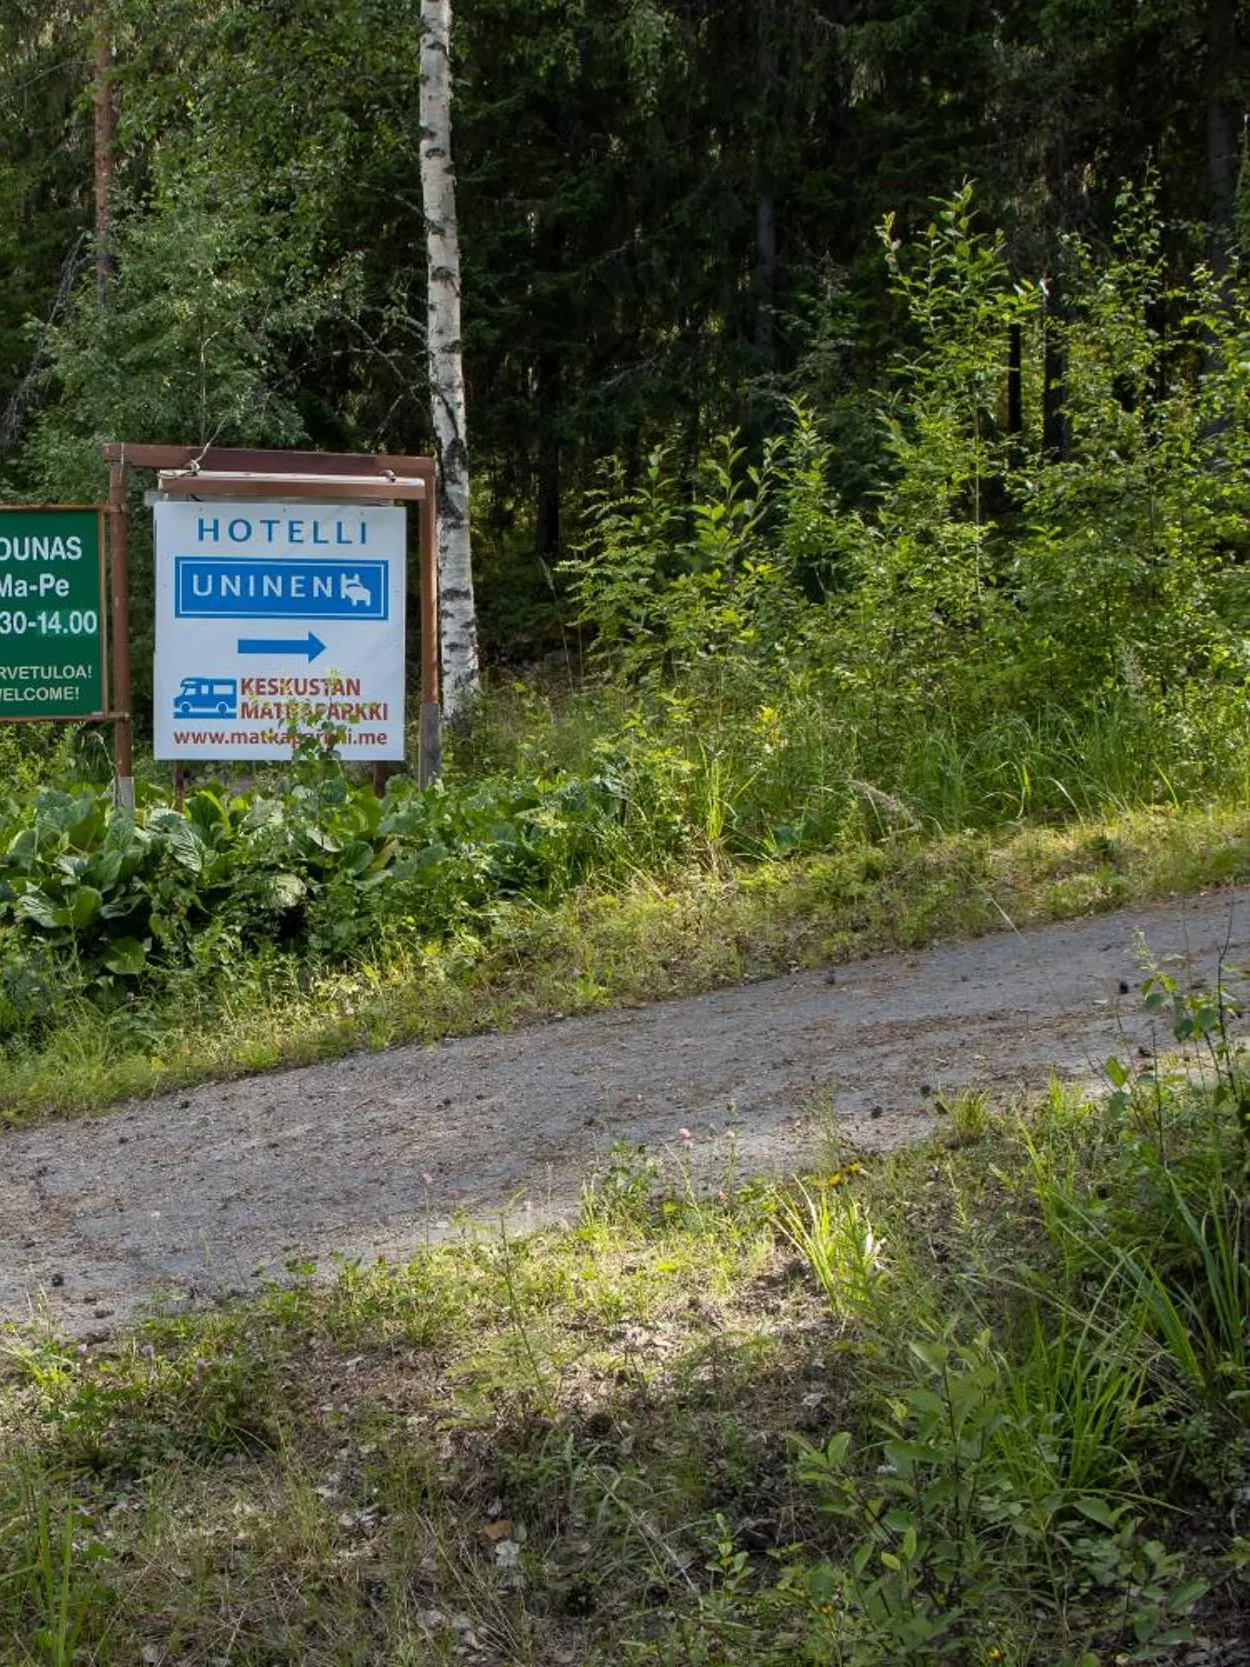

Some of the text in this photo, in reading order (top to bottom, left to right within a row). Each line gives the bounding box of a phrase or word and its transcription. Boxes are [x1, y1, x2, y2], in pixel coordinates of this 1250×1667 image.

[198, 518, 367, 545] HOTELLI
[192, 573, 332, 598] UNINEN
[241, 678, 360, 696] KESKUSTAN
